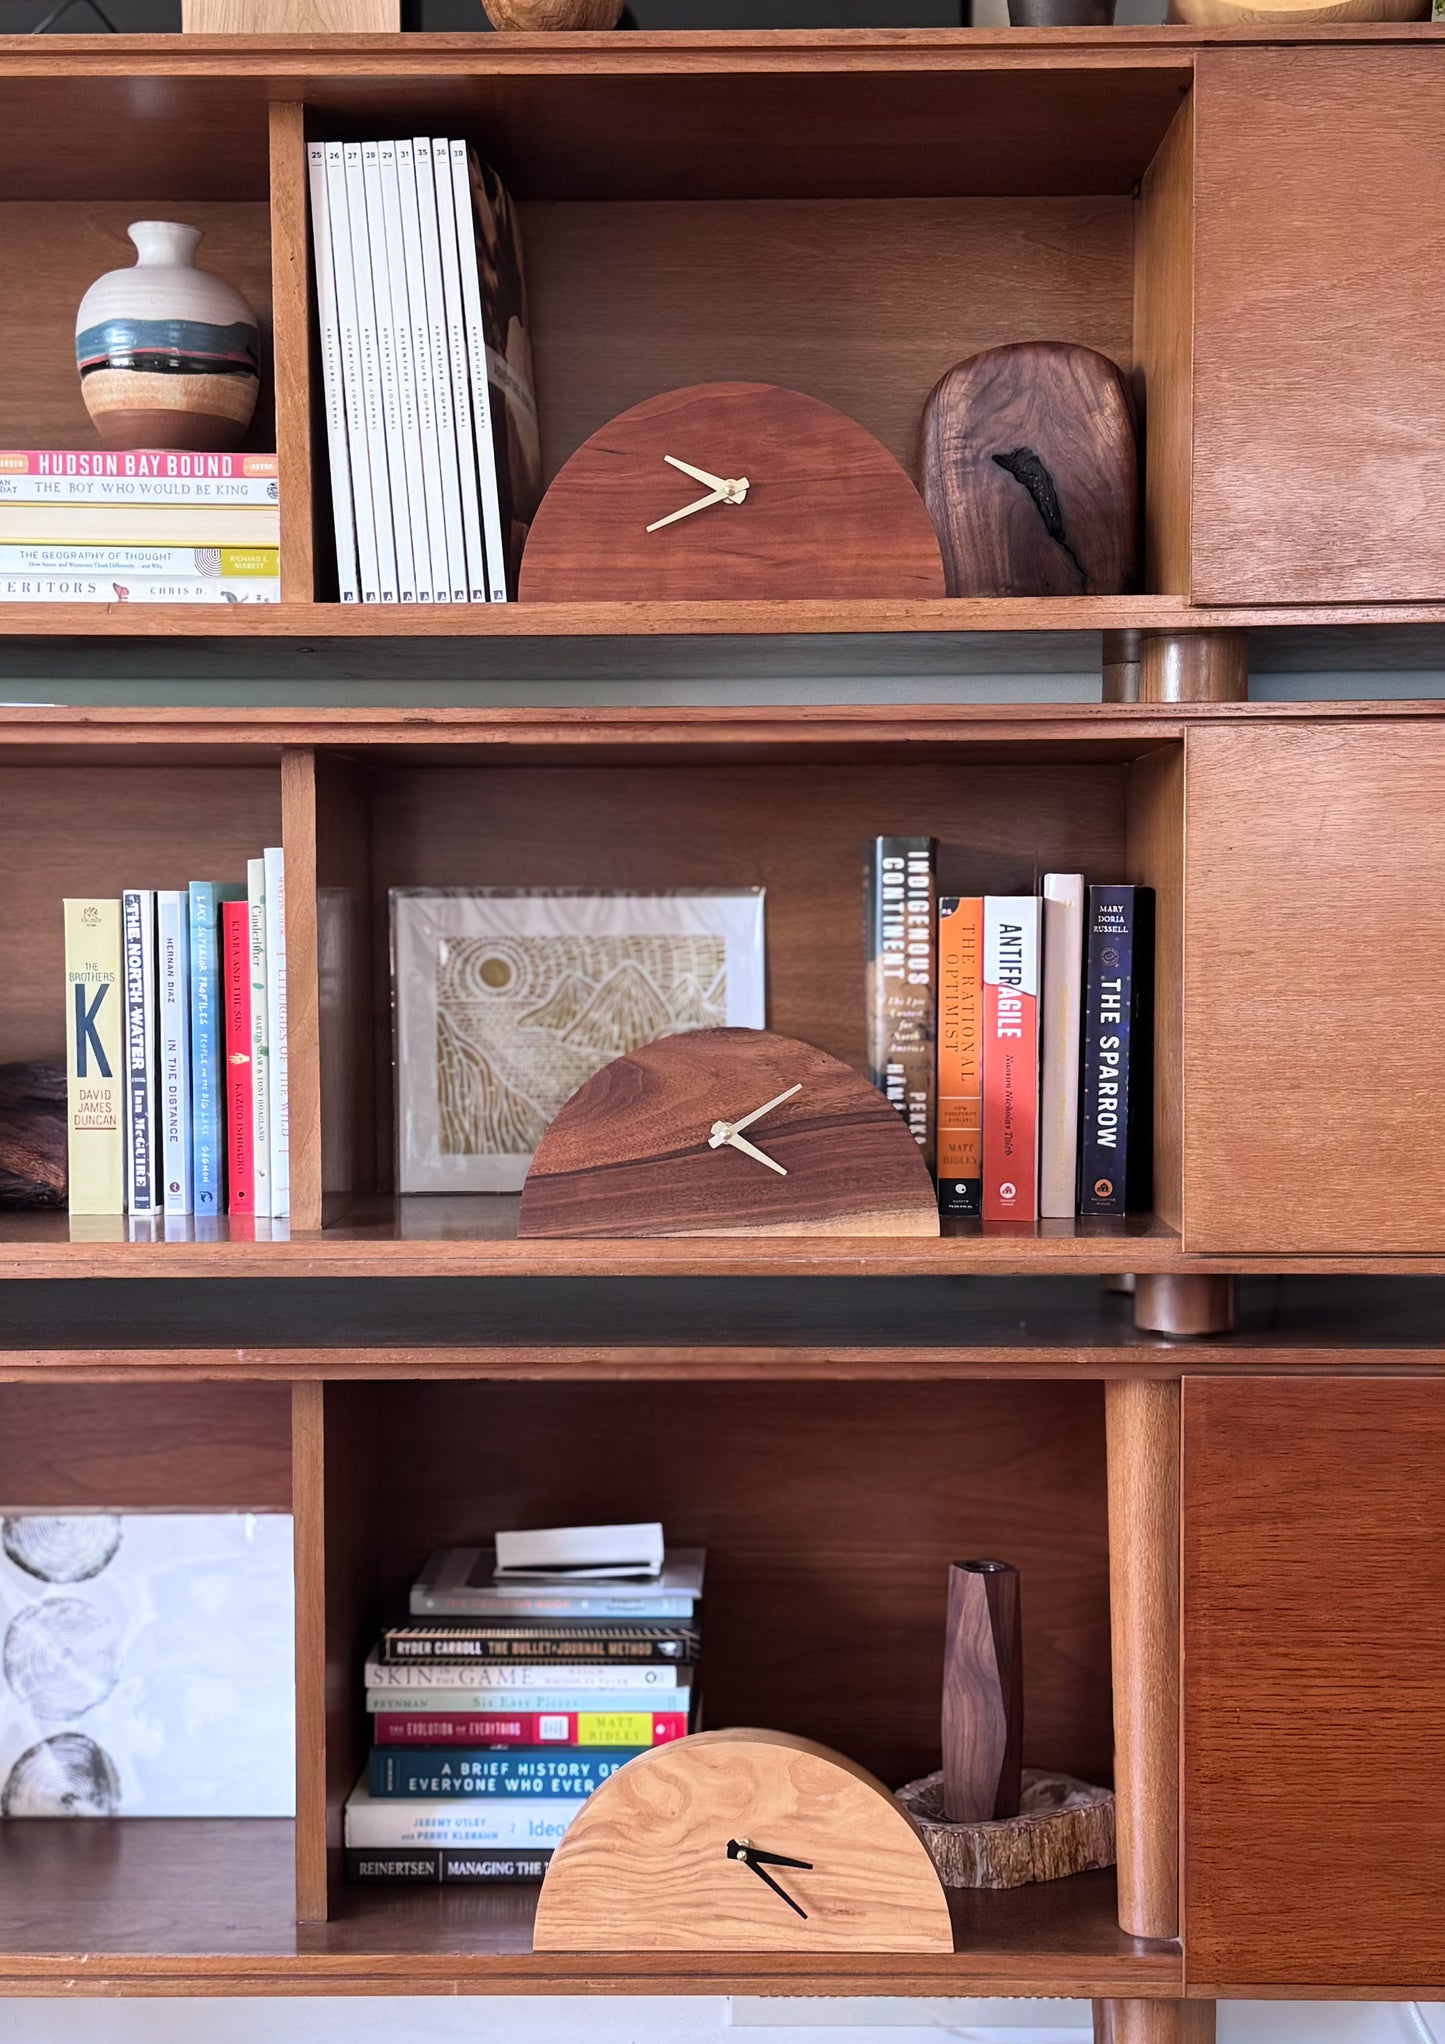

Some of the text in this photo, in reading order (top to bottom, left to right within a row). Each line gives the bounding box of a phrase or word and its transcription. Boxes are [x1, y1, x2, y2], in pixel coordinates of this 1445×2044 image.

[329, 152, 340, 160] 26
[348, 152, 357, 160] 27
[400, 150, 410, 158] 31
[418, 148, 428, 156] 35
[327, 328, 335, 382] ADVENTURE
[347, 328, 359, 430] ADVENTURE JOURNAL
[365, 328, 377, 430] ADVENTURE JOURNAL
[383, 328, 396, 430] ADVENTURE JOURNAL
[400, 328, 413, 430] ADVENTURE JOURNAL
[418, 327, 431, 430] ADVENTURE JOURNAL
[435, 325, 448, 428] ADVENTURE JOURNAL
[453, 325, 466, 428] ADVENTURE JOURNAL
[472, 326, 486, 429] ADVENTURE JOURNAL
[39, 454, 117, 475] HUDSON
[125, 455, 160, 476] BAY
[167, 456, 232, 477] BOUND
[34, 482, 248, 496] THE BOY WHO WOULD BE KING
[20, 550, 172, 561] THE GEOGRAPHY OF THOUGHT
[0, 581, 96, 593] ERITORS
[150, 586, 189, 595] CHRIS
[127, 904, 140, 940] THE
[196, 896, 206, 921] LAKE
[882, 857, 905, 980] CONTINENT
[907, 852, 930, 985] INDIGENOUS
[198, 926, 208, 972] SUPERIOR
[69, 972, 115, 982] BROTHERS
[86, 962, 98, 971] THE
[128, 943, 144, 1003] NORTH
[166, 938, 176, 1004] HERNAN DIAZ
[232, 920, 242, 1032] KLARA AND THE SUN
[998, 924, 1023, 1038] ANTIFRAGILE
[198, 976, 208, 1025] PROFILES
[278, 969, 287, 1041] LITURGIES
[945, 954, 960, 1053] OPTIMIST
[960, 924, 976, 1082] THE RATIONAL
[1100, 978, 1121, 1024] THE
[74, 984, 113, 1078] K
[894, 1031, 920, 1041] North
[898, 1020, 913, 1030] for
[130, 1008, 145, 1070] WATER
[200, 1034, 208, 1064] PEOPLE
[279, 1046, 288, 1063] OF
[1004, 1054, 1014, 1089] Nassim
[79, 1089, 112, 1100] DAVID
[168, 1040, 178, 1143] IN THE DISTANCE
[200, 1093, 209, 1110] BIG
[1097, 1036, 1120, 1148] SPARROW
[74, 1114, 117, 1126] DUNCAN
[78, 1102, 112, 1113] JAMES
[281, 1102, 290, 1137] WILD
[1004, 1090, 1014, 1130] Nicholas
[235, 1083, 245, 1174] KAZUO ISHIGURO
[942, 1156, 977, 1165] RIDLEY
[948, 1144, 974, 1152] MATT
[201, 1146, 209, 1183] GAGNON
[396, 1640, 652, 1656] RYDER CARROLL THE METHOD
[372, 1666, 433, 1686] SKIN
[458, 1666, 534, 1686] GAME
[373, 1696, 578, 1709] FEYNMAN Six Easy Pieces
[406, 1722, 454, 1736] EVOLUTION
[468, 1722, 520, 1736] EVERYTHING
[596, 1716, 634, 1728] MATT
[589, 1731, 641, 1742] RIDLEY
[441, 1762, 452, 1776] A
[460, 1762, 510, 1776] BRIEF
[518, 1762, 591, 1777] HISTORY
[408, 1778, 595, 1793] EVERYONE WHO EVER
[413, 1818, 487, 1828] JEREMY UTLEY
[416, 1831, 449, 1840] PERRY
[452, 1831, 498, 1840] KLEBAHN
[359, 1861, 435, 1876] REINERTSEN
[447, 1861, 514, 1876] MANAGING
[516, 1861, 542, 1876] THE
